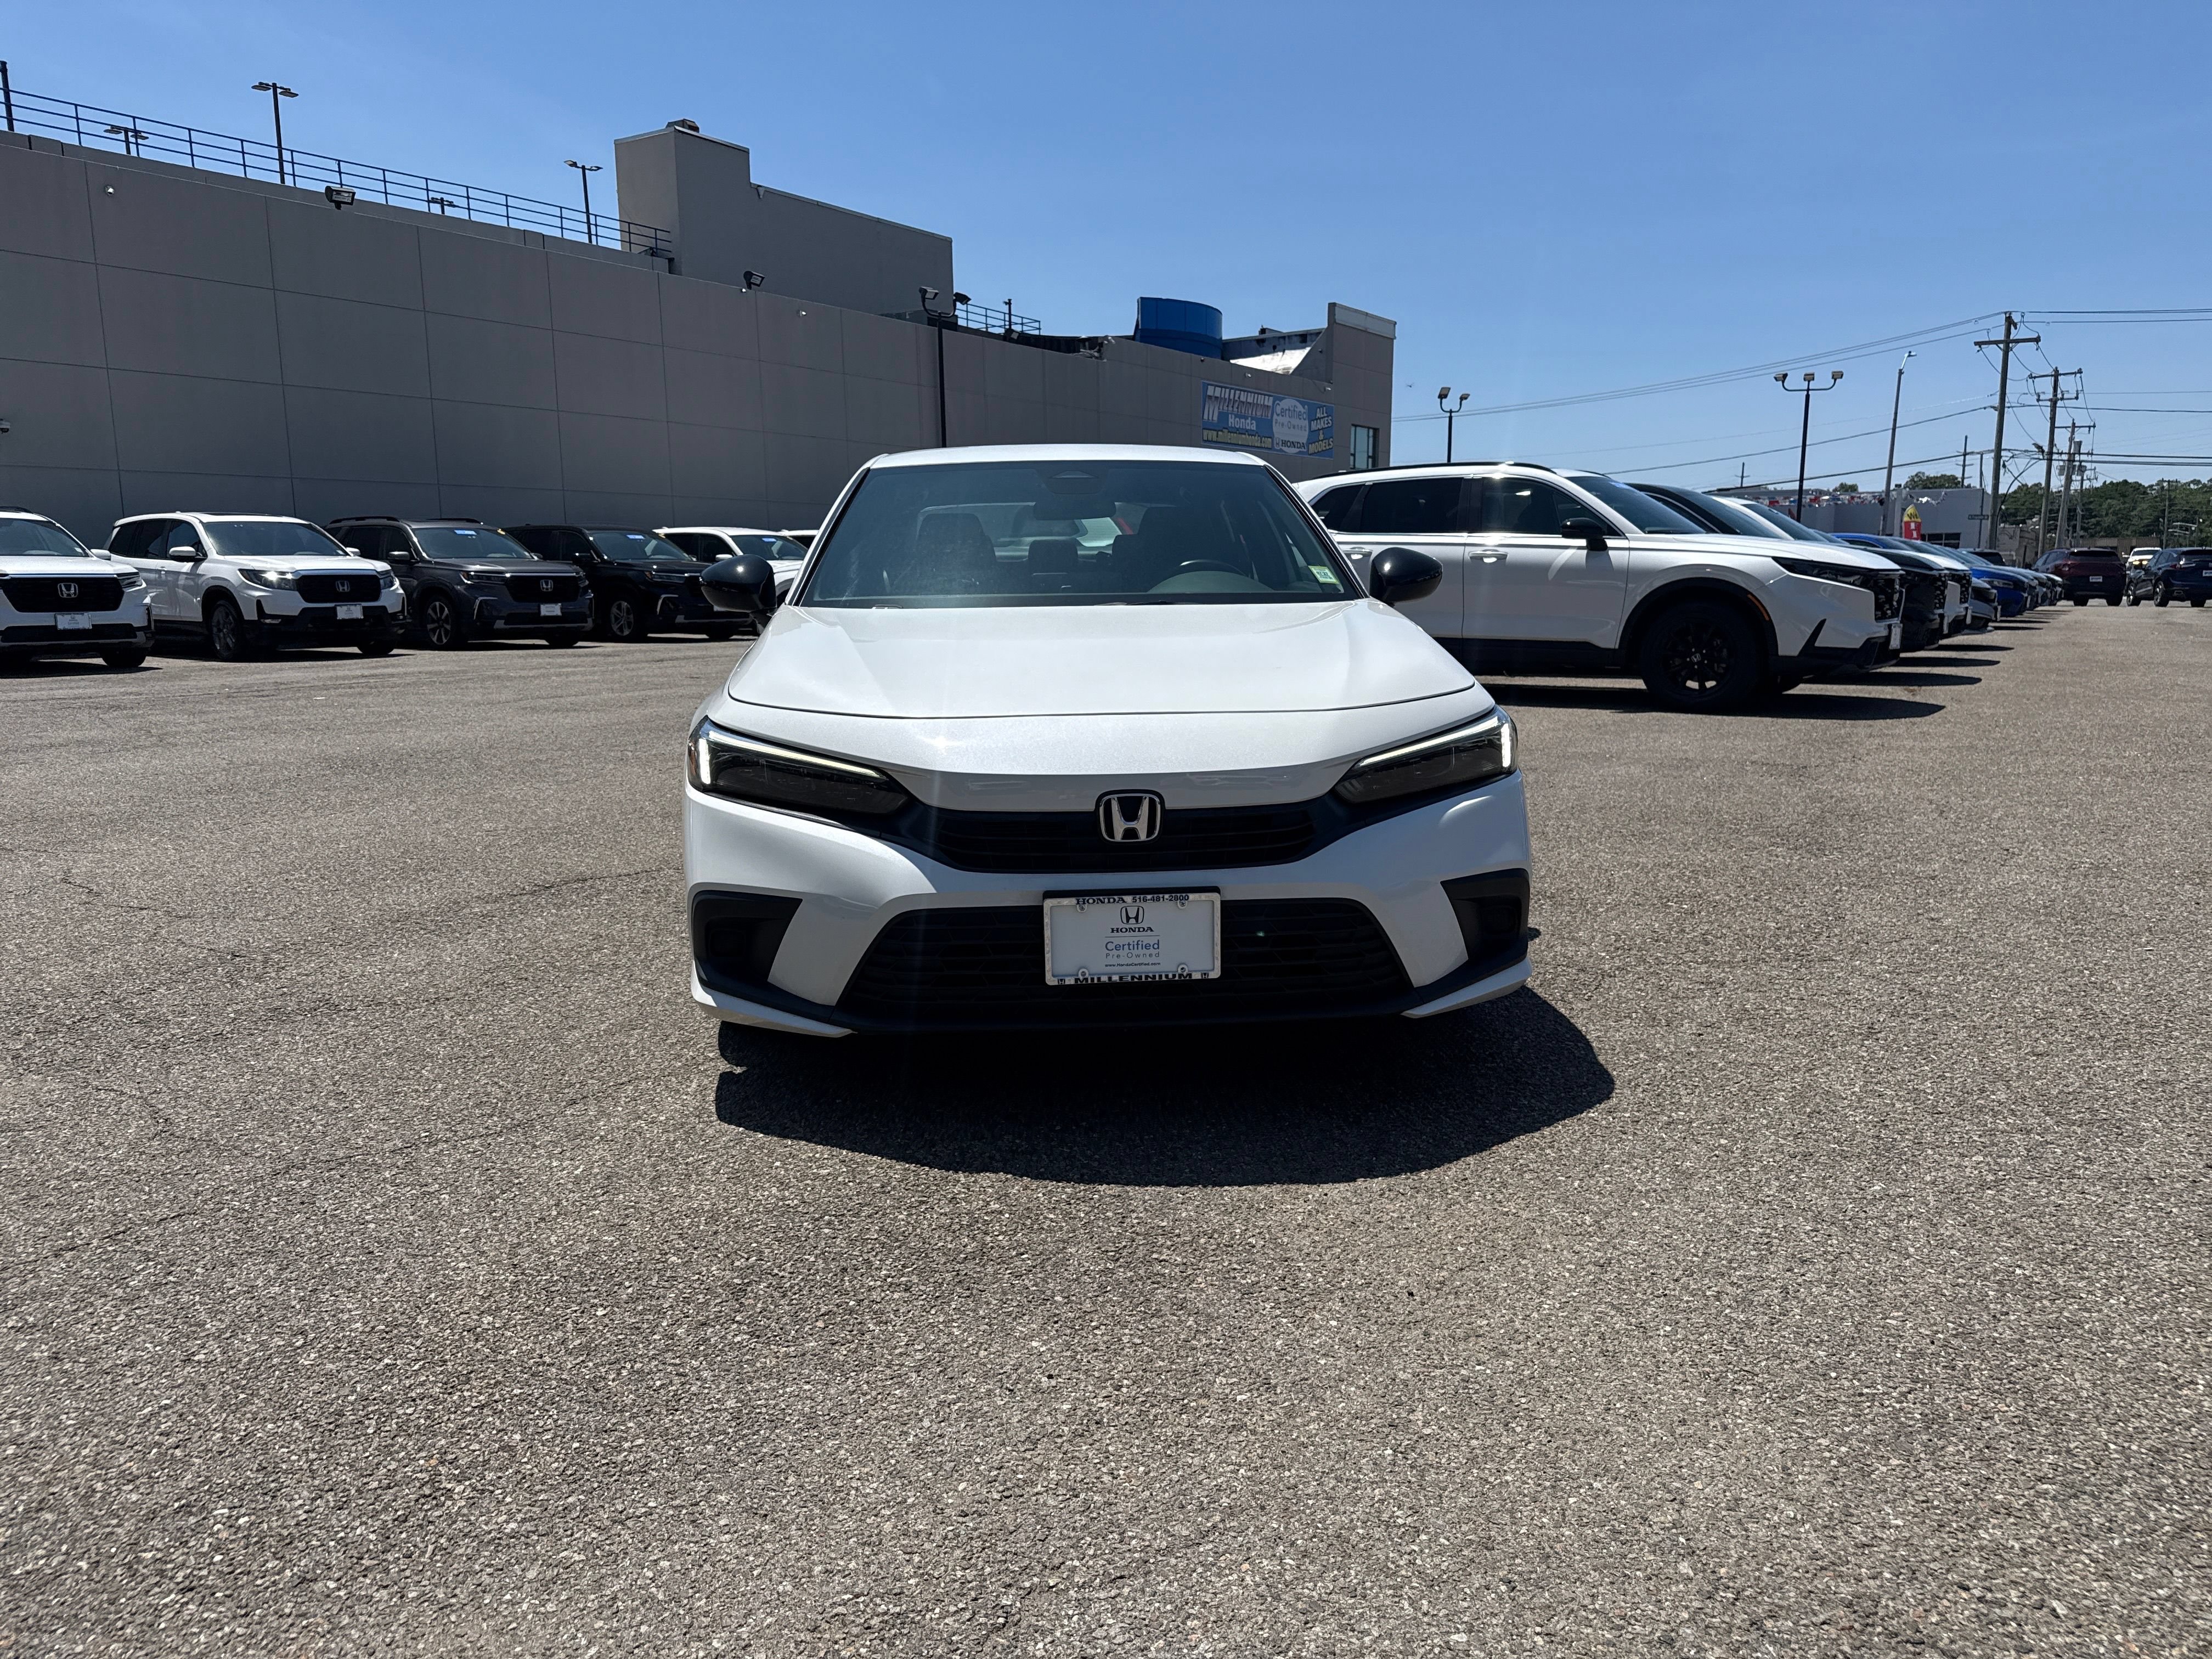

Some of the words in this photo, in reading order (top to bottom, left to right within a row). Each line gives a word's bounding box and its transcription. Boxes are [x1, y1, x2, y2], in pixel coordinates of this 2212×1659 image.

[1276, 403, 1307, 421] Certified
[1317, 407, 1328, 419] ALL
[1228, 414, 1256, 431] Honda
[1274, 419, 1307, 432] Pre-Owned
[1311, 416, 1332, 432] MAKES
[1319, 430, 1324, 440] &
[1281, 439, 1306, 450] HONDA
[1308, 438, 1334, 454] MODELS
[1075, 896, 1127, 905] HONDA
[1132, 894, 1189, 903] 516-481-2800
[1105, 939, 1160, 951] Certified
[1074, 973, 1192, 984] MILLENNIUM
